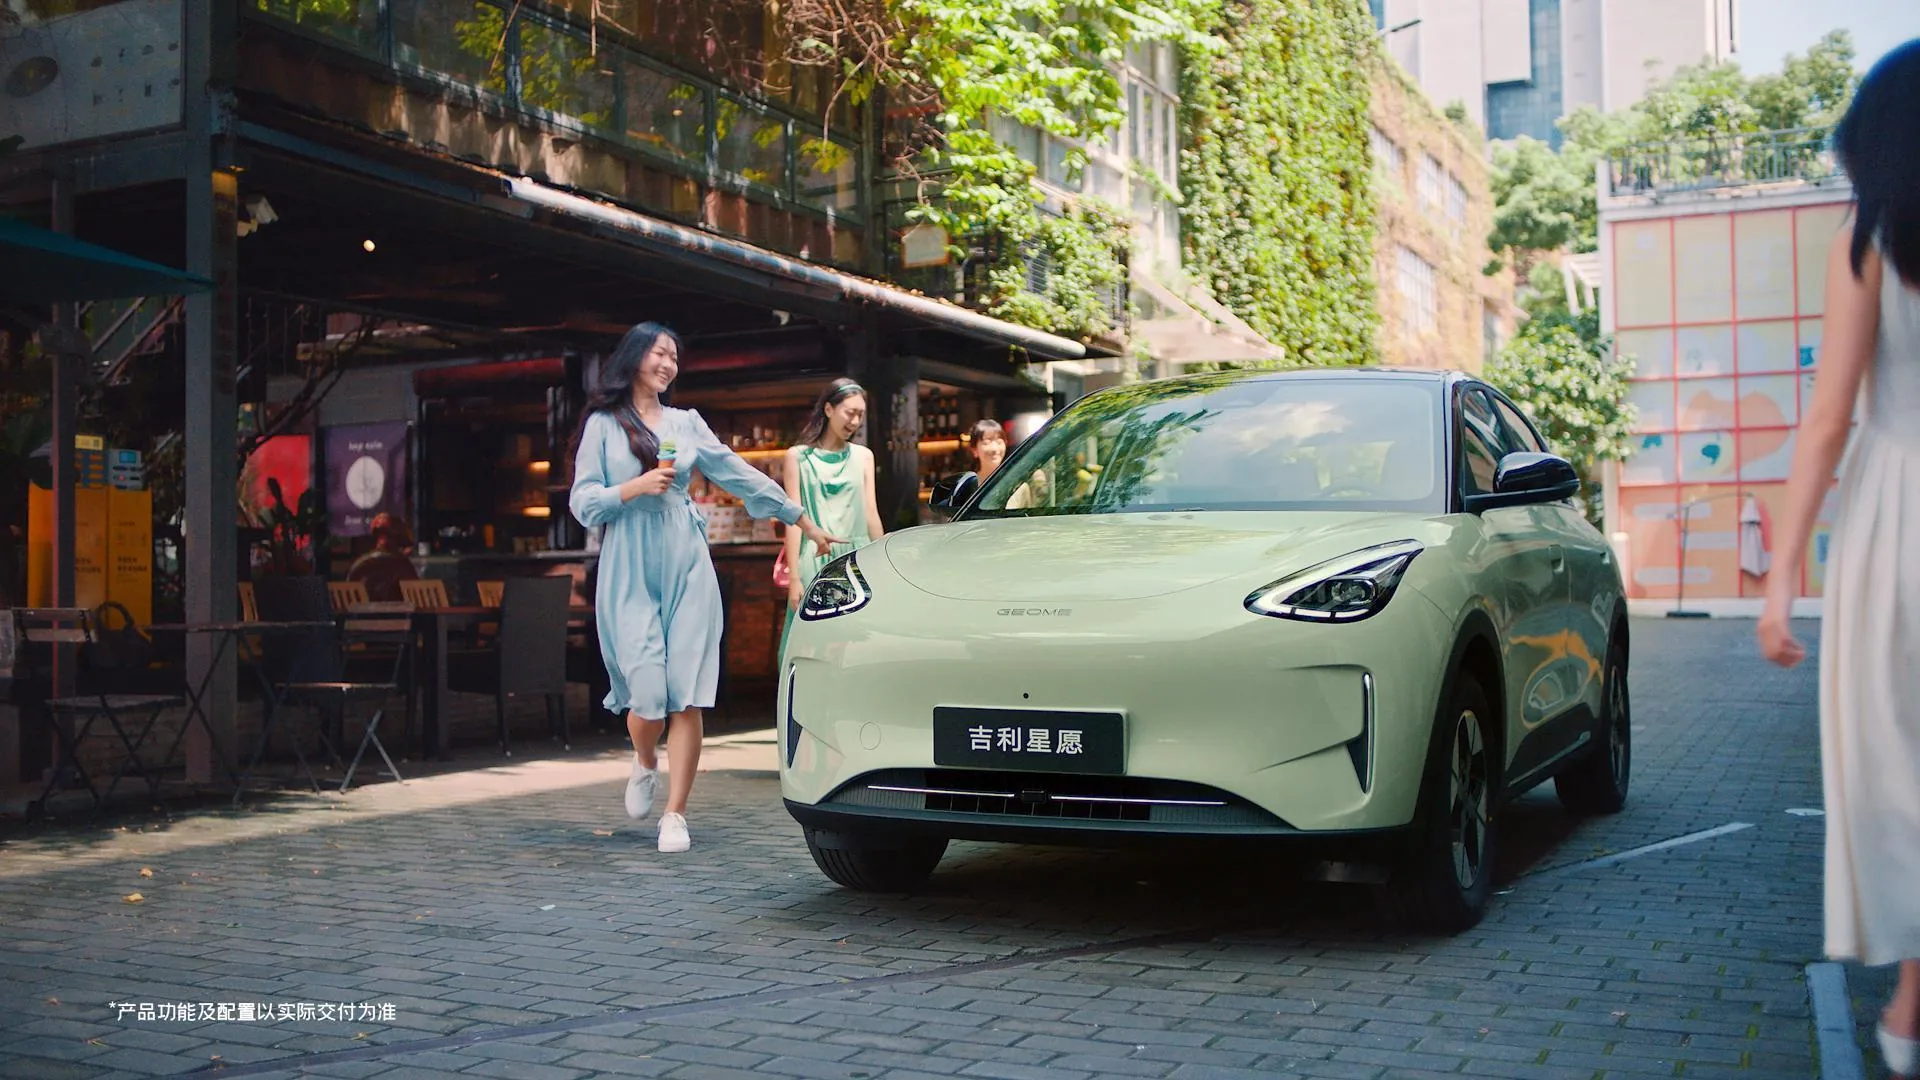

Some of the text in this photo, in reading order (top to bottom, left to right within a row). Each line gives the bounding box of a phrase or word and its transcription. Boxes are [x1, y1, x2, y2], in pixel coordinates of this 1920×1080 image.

[996, 608, 1073, 617] GEOME
[968, 725, 1083, 755] 吉利星愿
